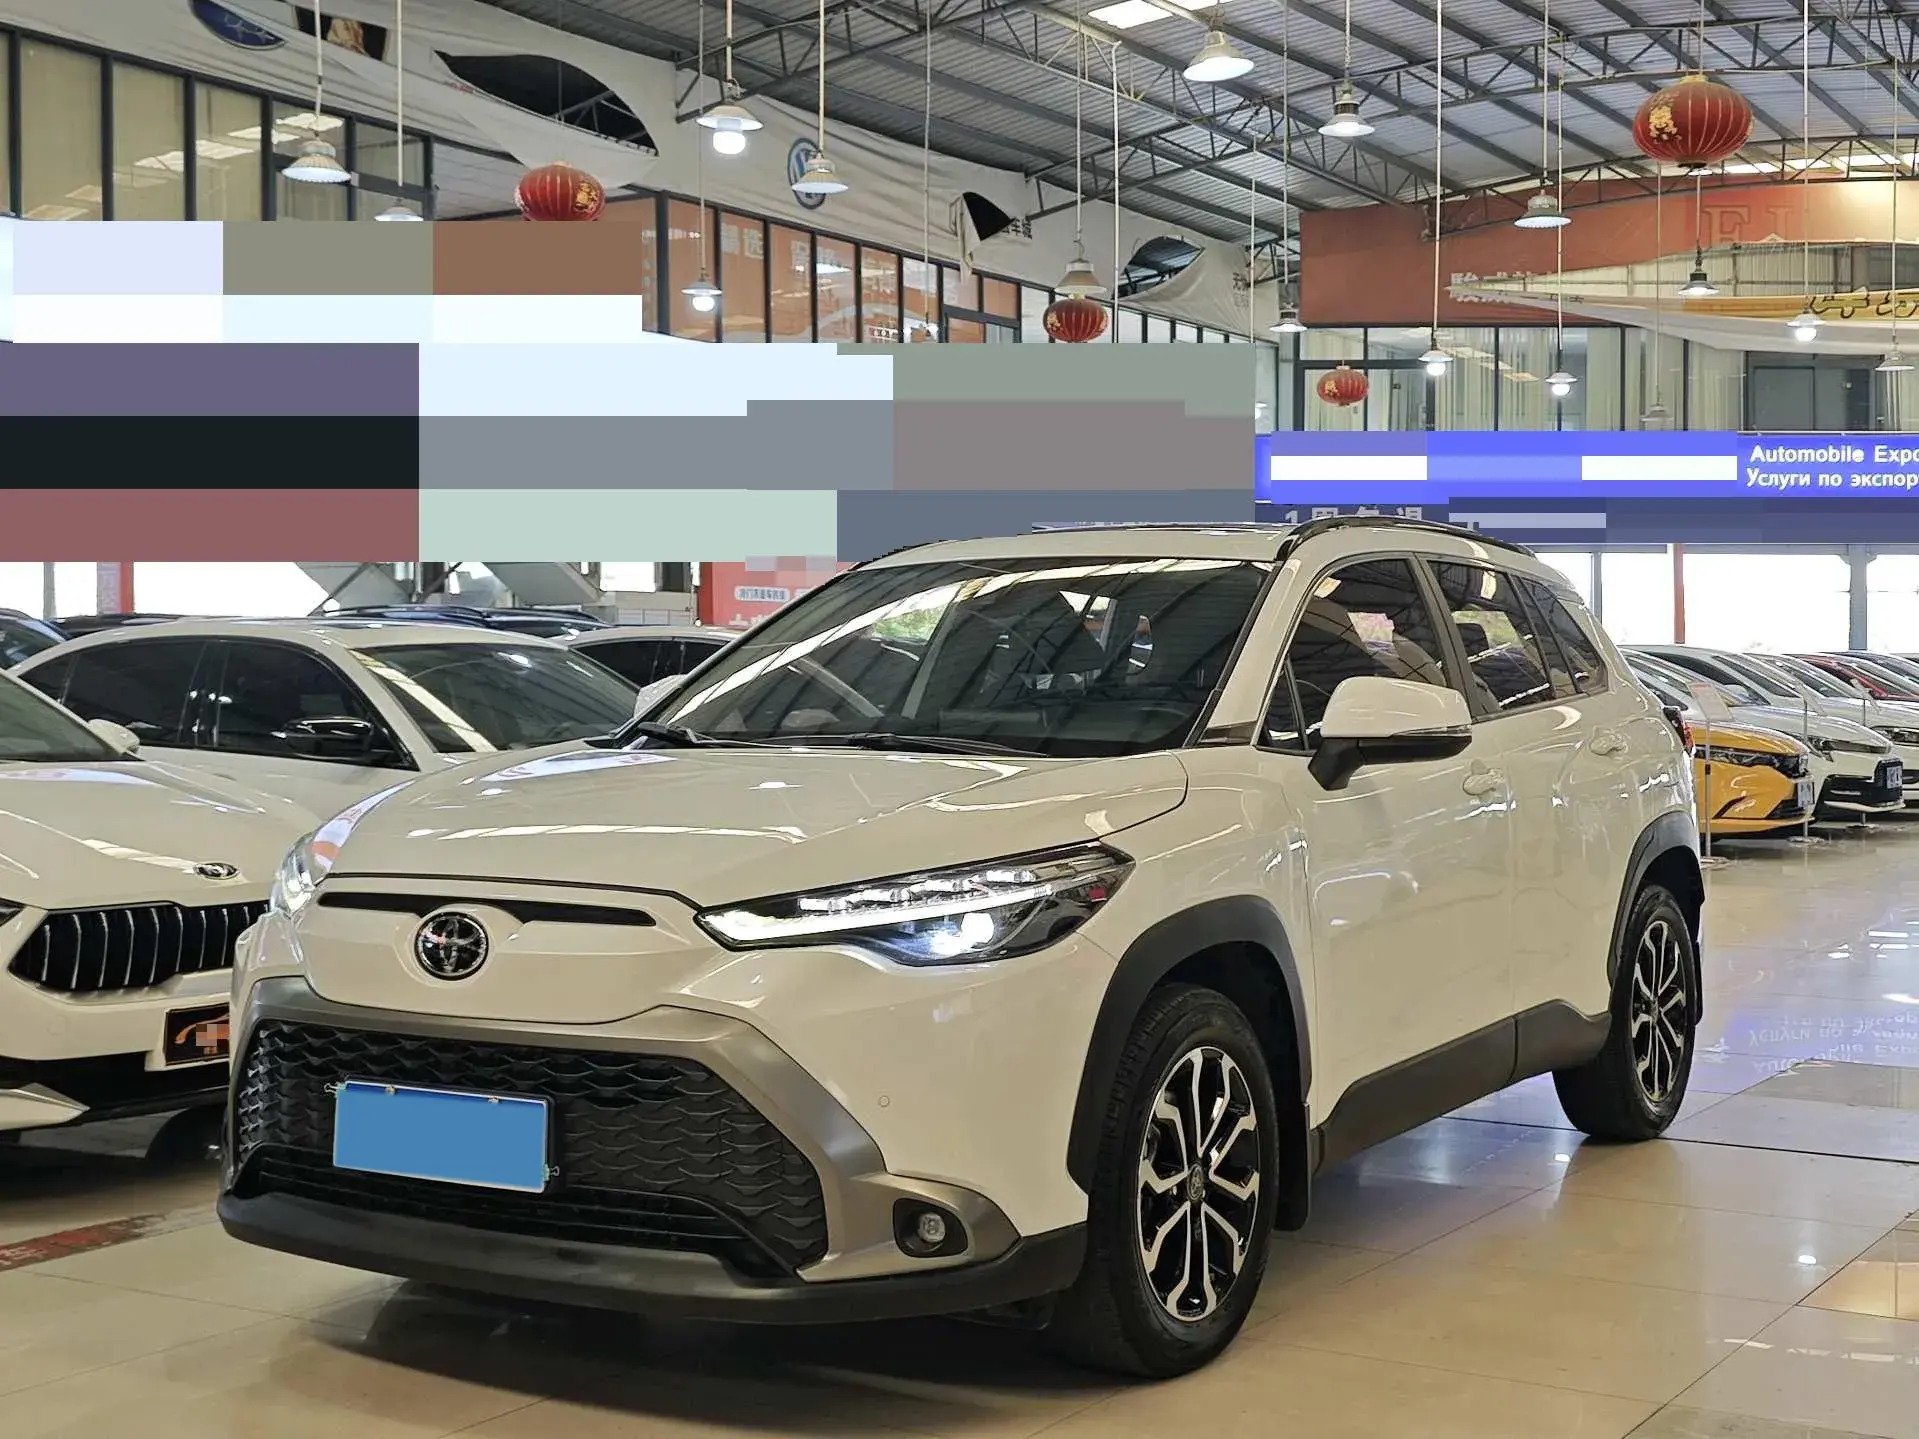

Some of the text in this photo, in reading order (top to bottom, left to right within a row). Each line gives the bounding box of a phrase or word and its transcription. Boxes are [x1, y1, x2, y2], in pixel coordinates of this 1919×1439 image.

[1750, 445, 1865, 463] Automobile
[1746, 467, 1919, 491] Услуги по экспор
